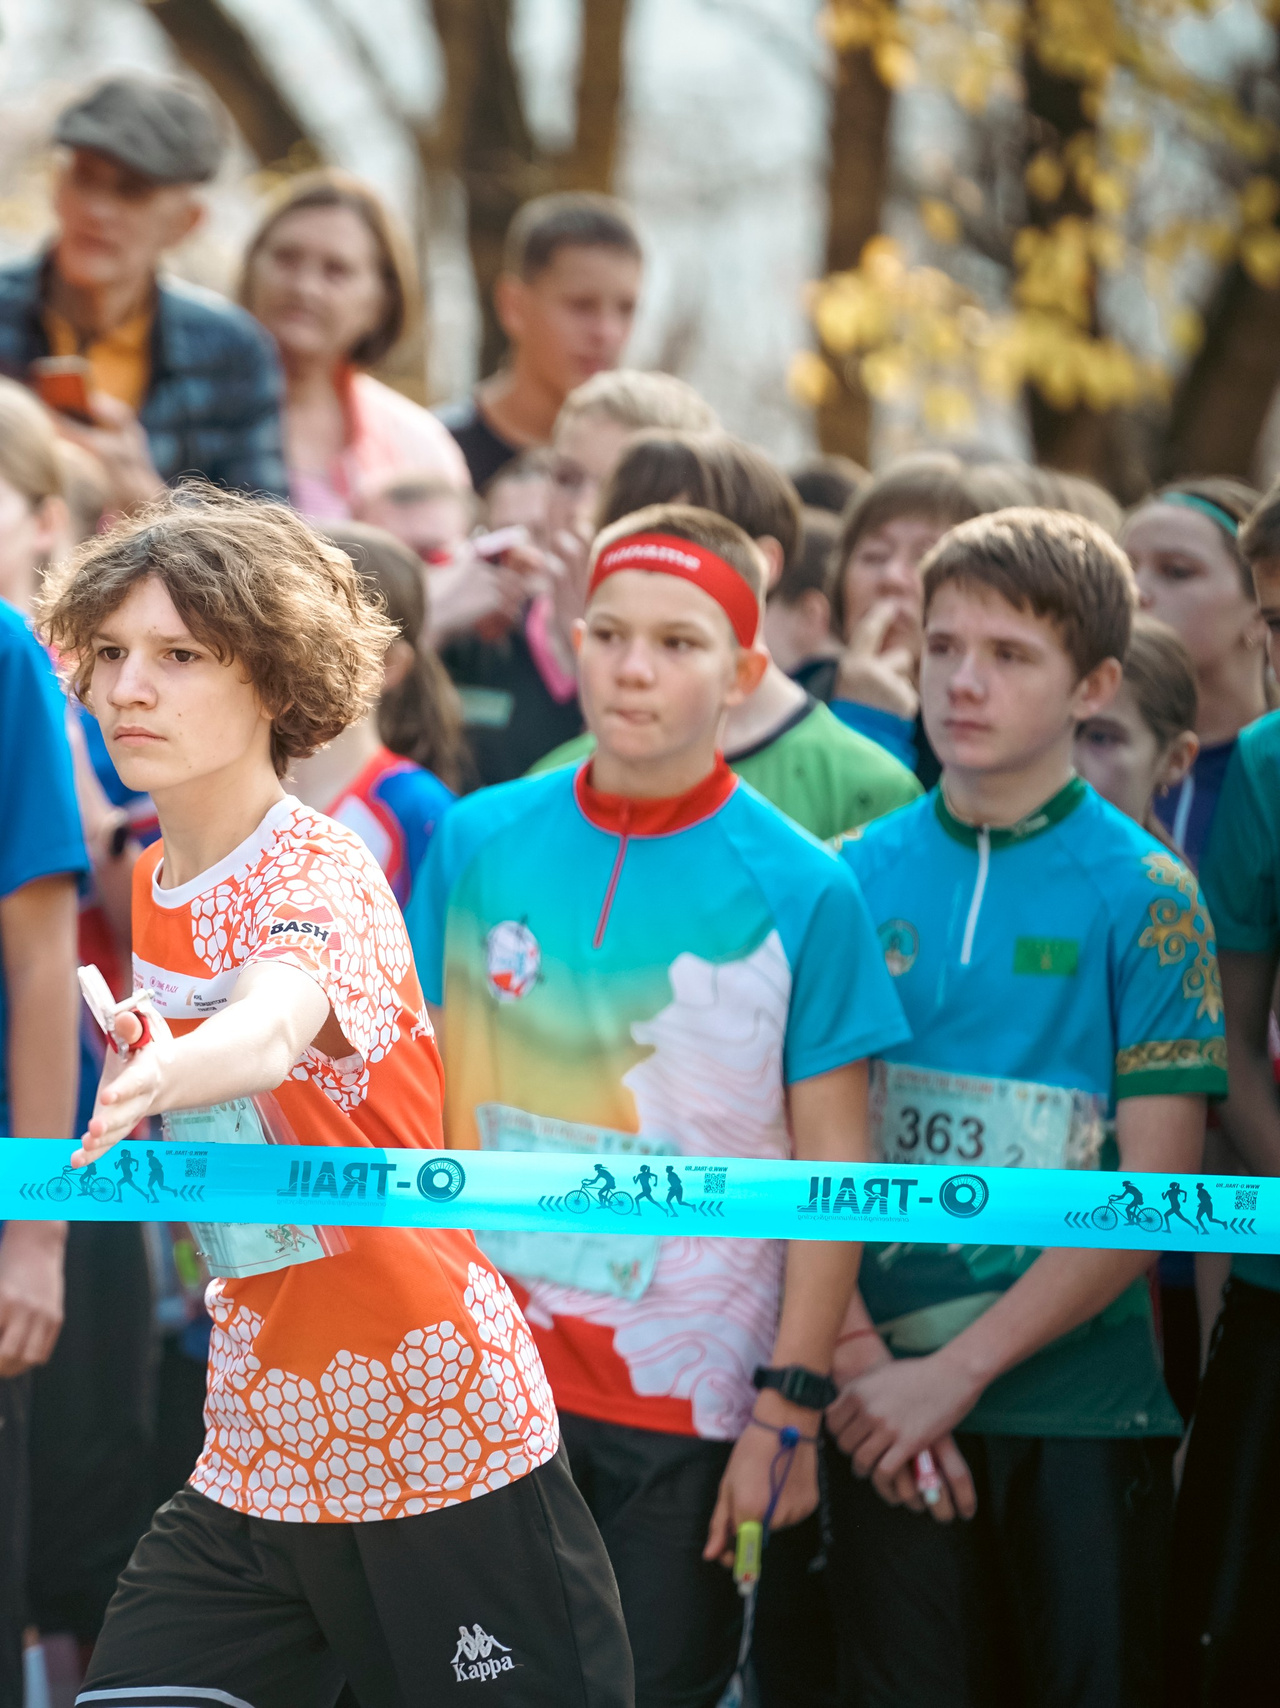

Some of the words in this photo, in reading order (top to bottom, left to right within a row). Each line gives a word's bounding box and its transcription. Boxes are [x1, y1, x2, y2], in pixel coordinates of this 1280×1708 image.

[270, 921, 329, 942] BASH
[896, 1106, 985, 1160] 363
[452, 1655, 515, 1682] Kappa
